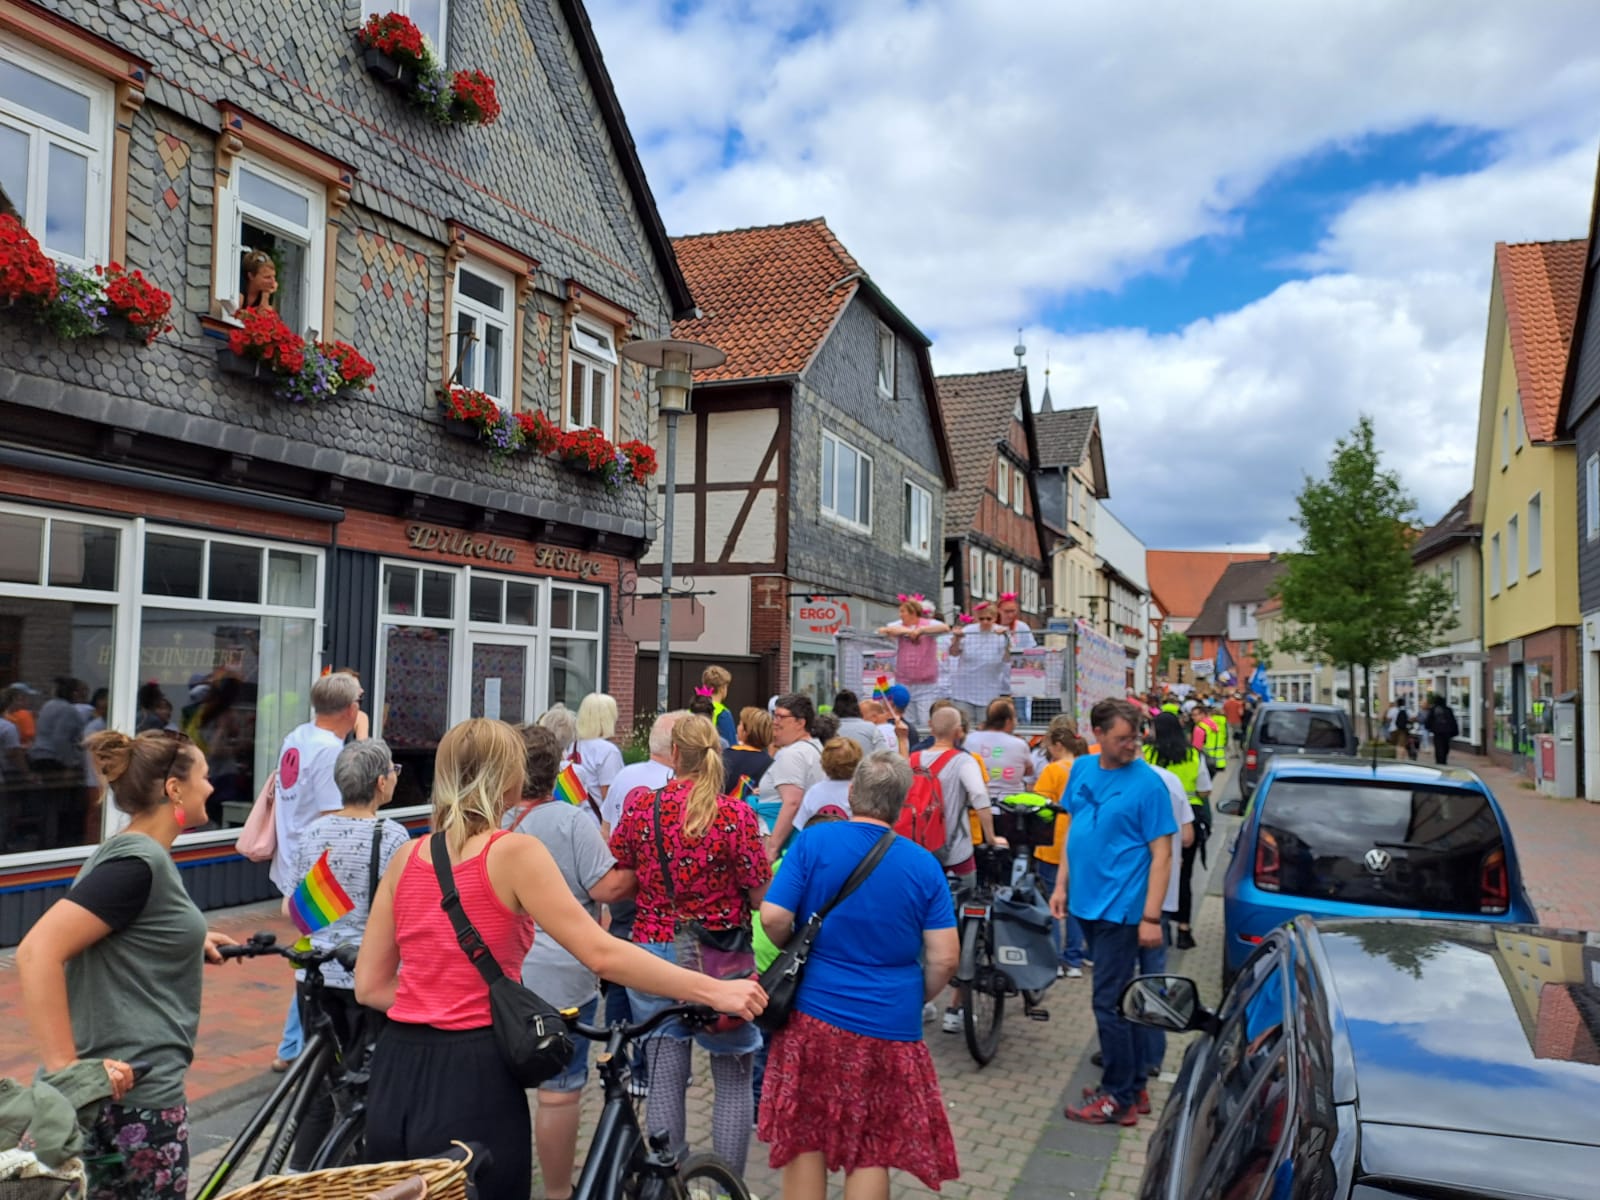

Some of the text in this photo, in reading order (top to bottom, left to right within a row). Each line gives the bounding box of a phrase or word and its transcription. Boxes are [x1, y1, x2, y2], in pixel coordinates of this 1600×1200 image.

[406, 524, 602, 579] Wilhelm Höltge
[799, 608, 836, 620] ERGO
[97, 644, 247, 666] HSCHNEIDEREI
[268, 1116, 298, 1175] alkhoff
